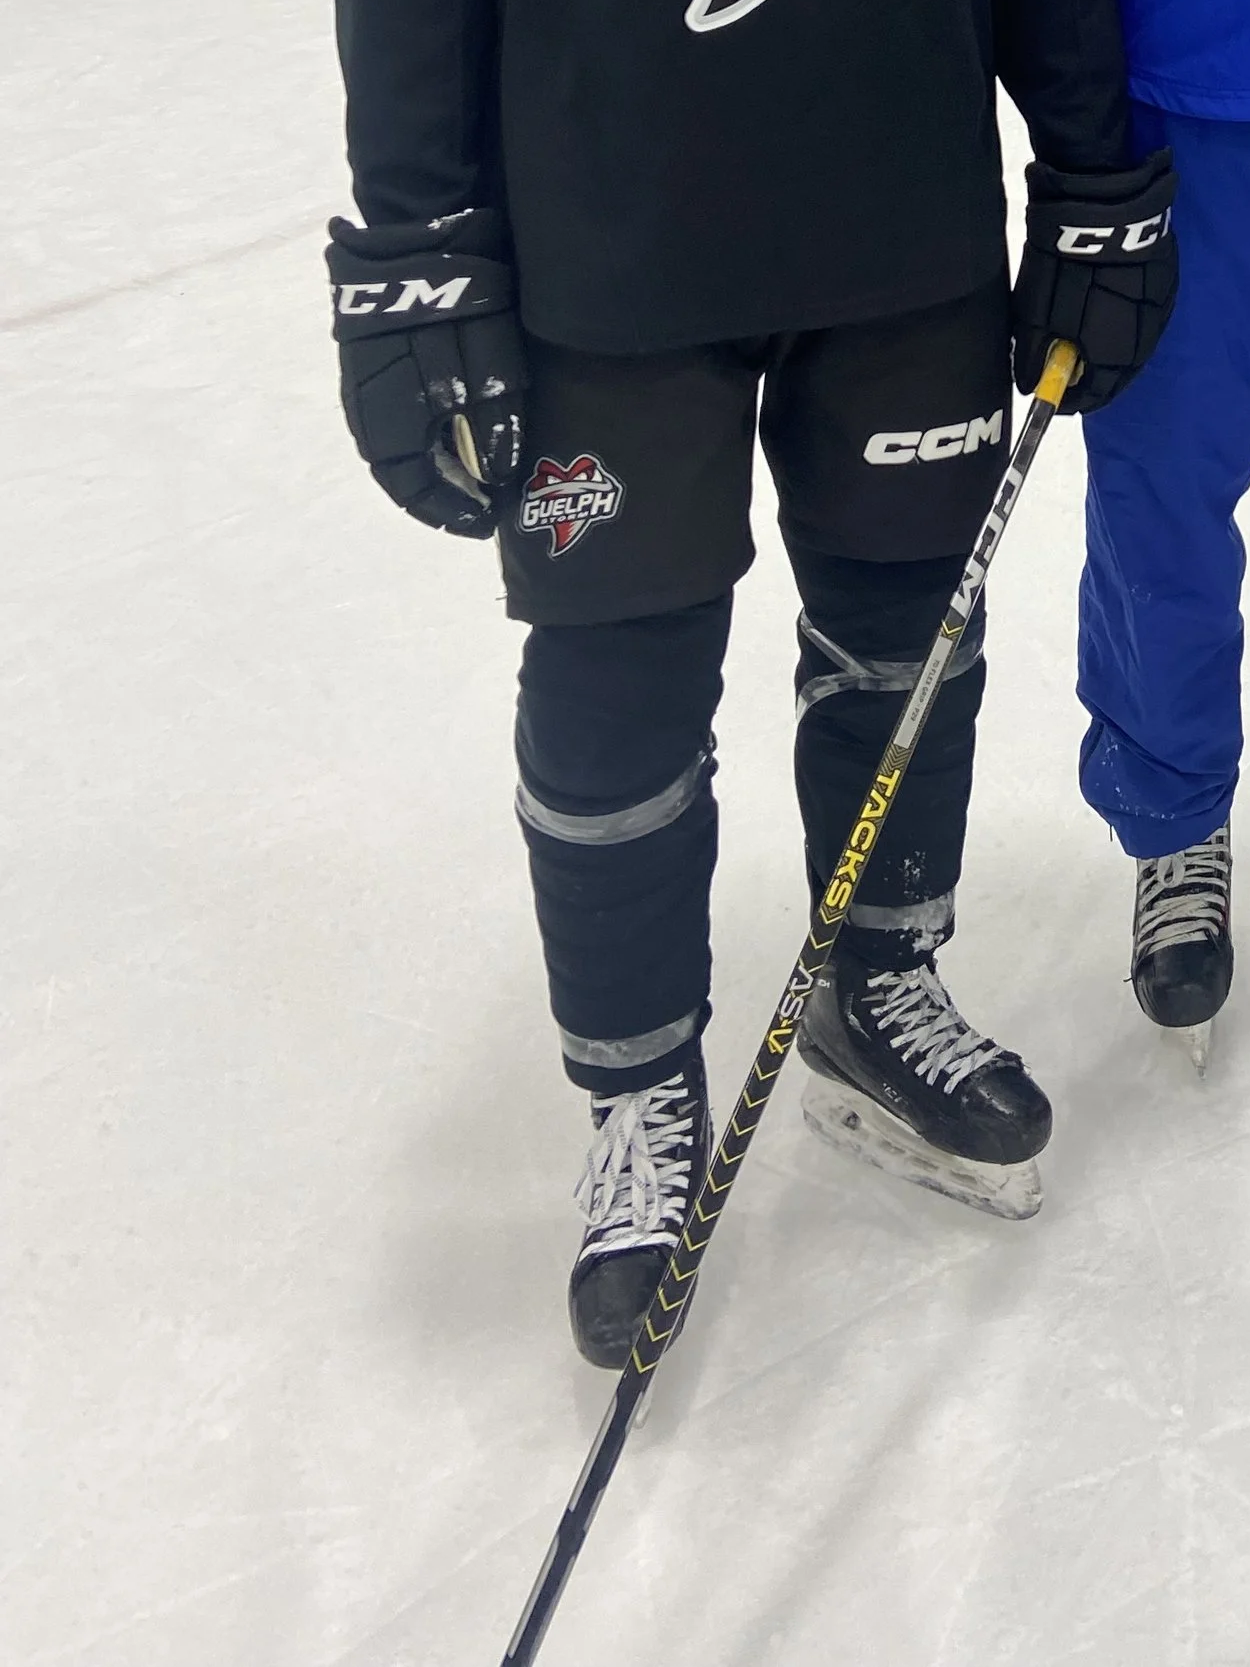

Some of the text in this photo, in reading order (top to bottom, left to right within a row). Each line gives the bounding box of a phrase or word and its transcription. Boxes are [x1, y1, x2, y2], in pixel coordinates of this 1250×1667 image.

[1056, 205, 1171, 254] CC
[332, 277, 472, 314] CM
[863, 410, 1003, 465] CCM
[522, 491, 616, 527] GUELPH
[826, 768, 901, 910] TACKS
